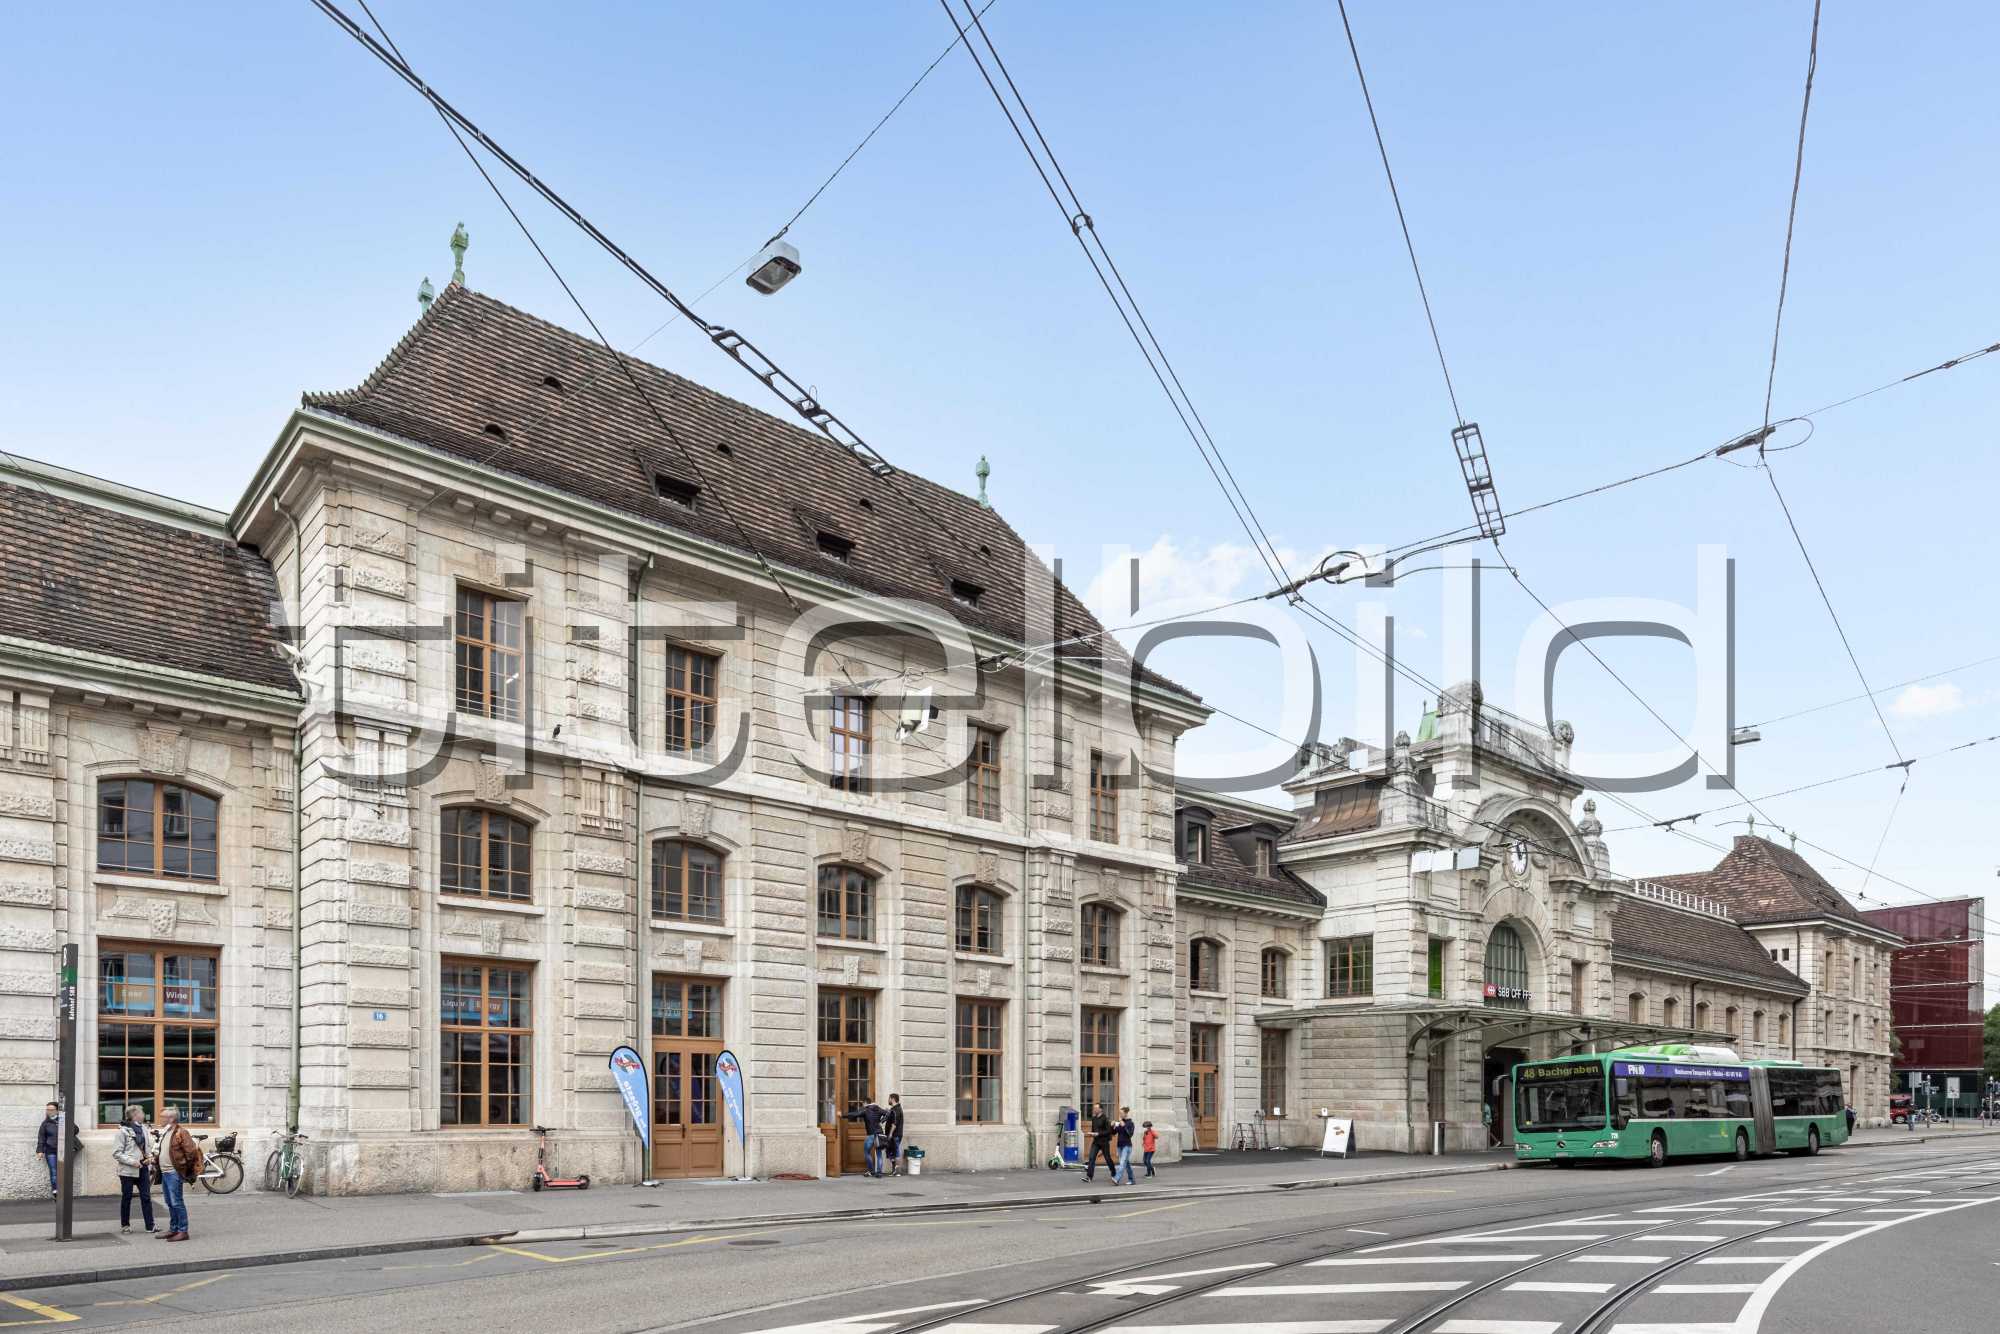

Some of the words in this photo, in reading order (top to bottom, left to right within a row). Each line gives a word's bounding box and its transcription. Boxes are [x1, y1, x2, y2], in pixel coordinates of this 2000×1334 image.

[165, 991, 188, 1000] Wine
[1497, 986, 1510, 998] SBB
[1523, 1069, 1536, 1079] 48
[1537, 1065, 1599, 1078] Bachgraben
